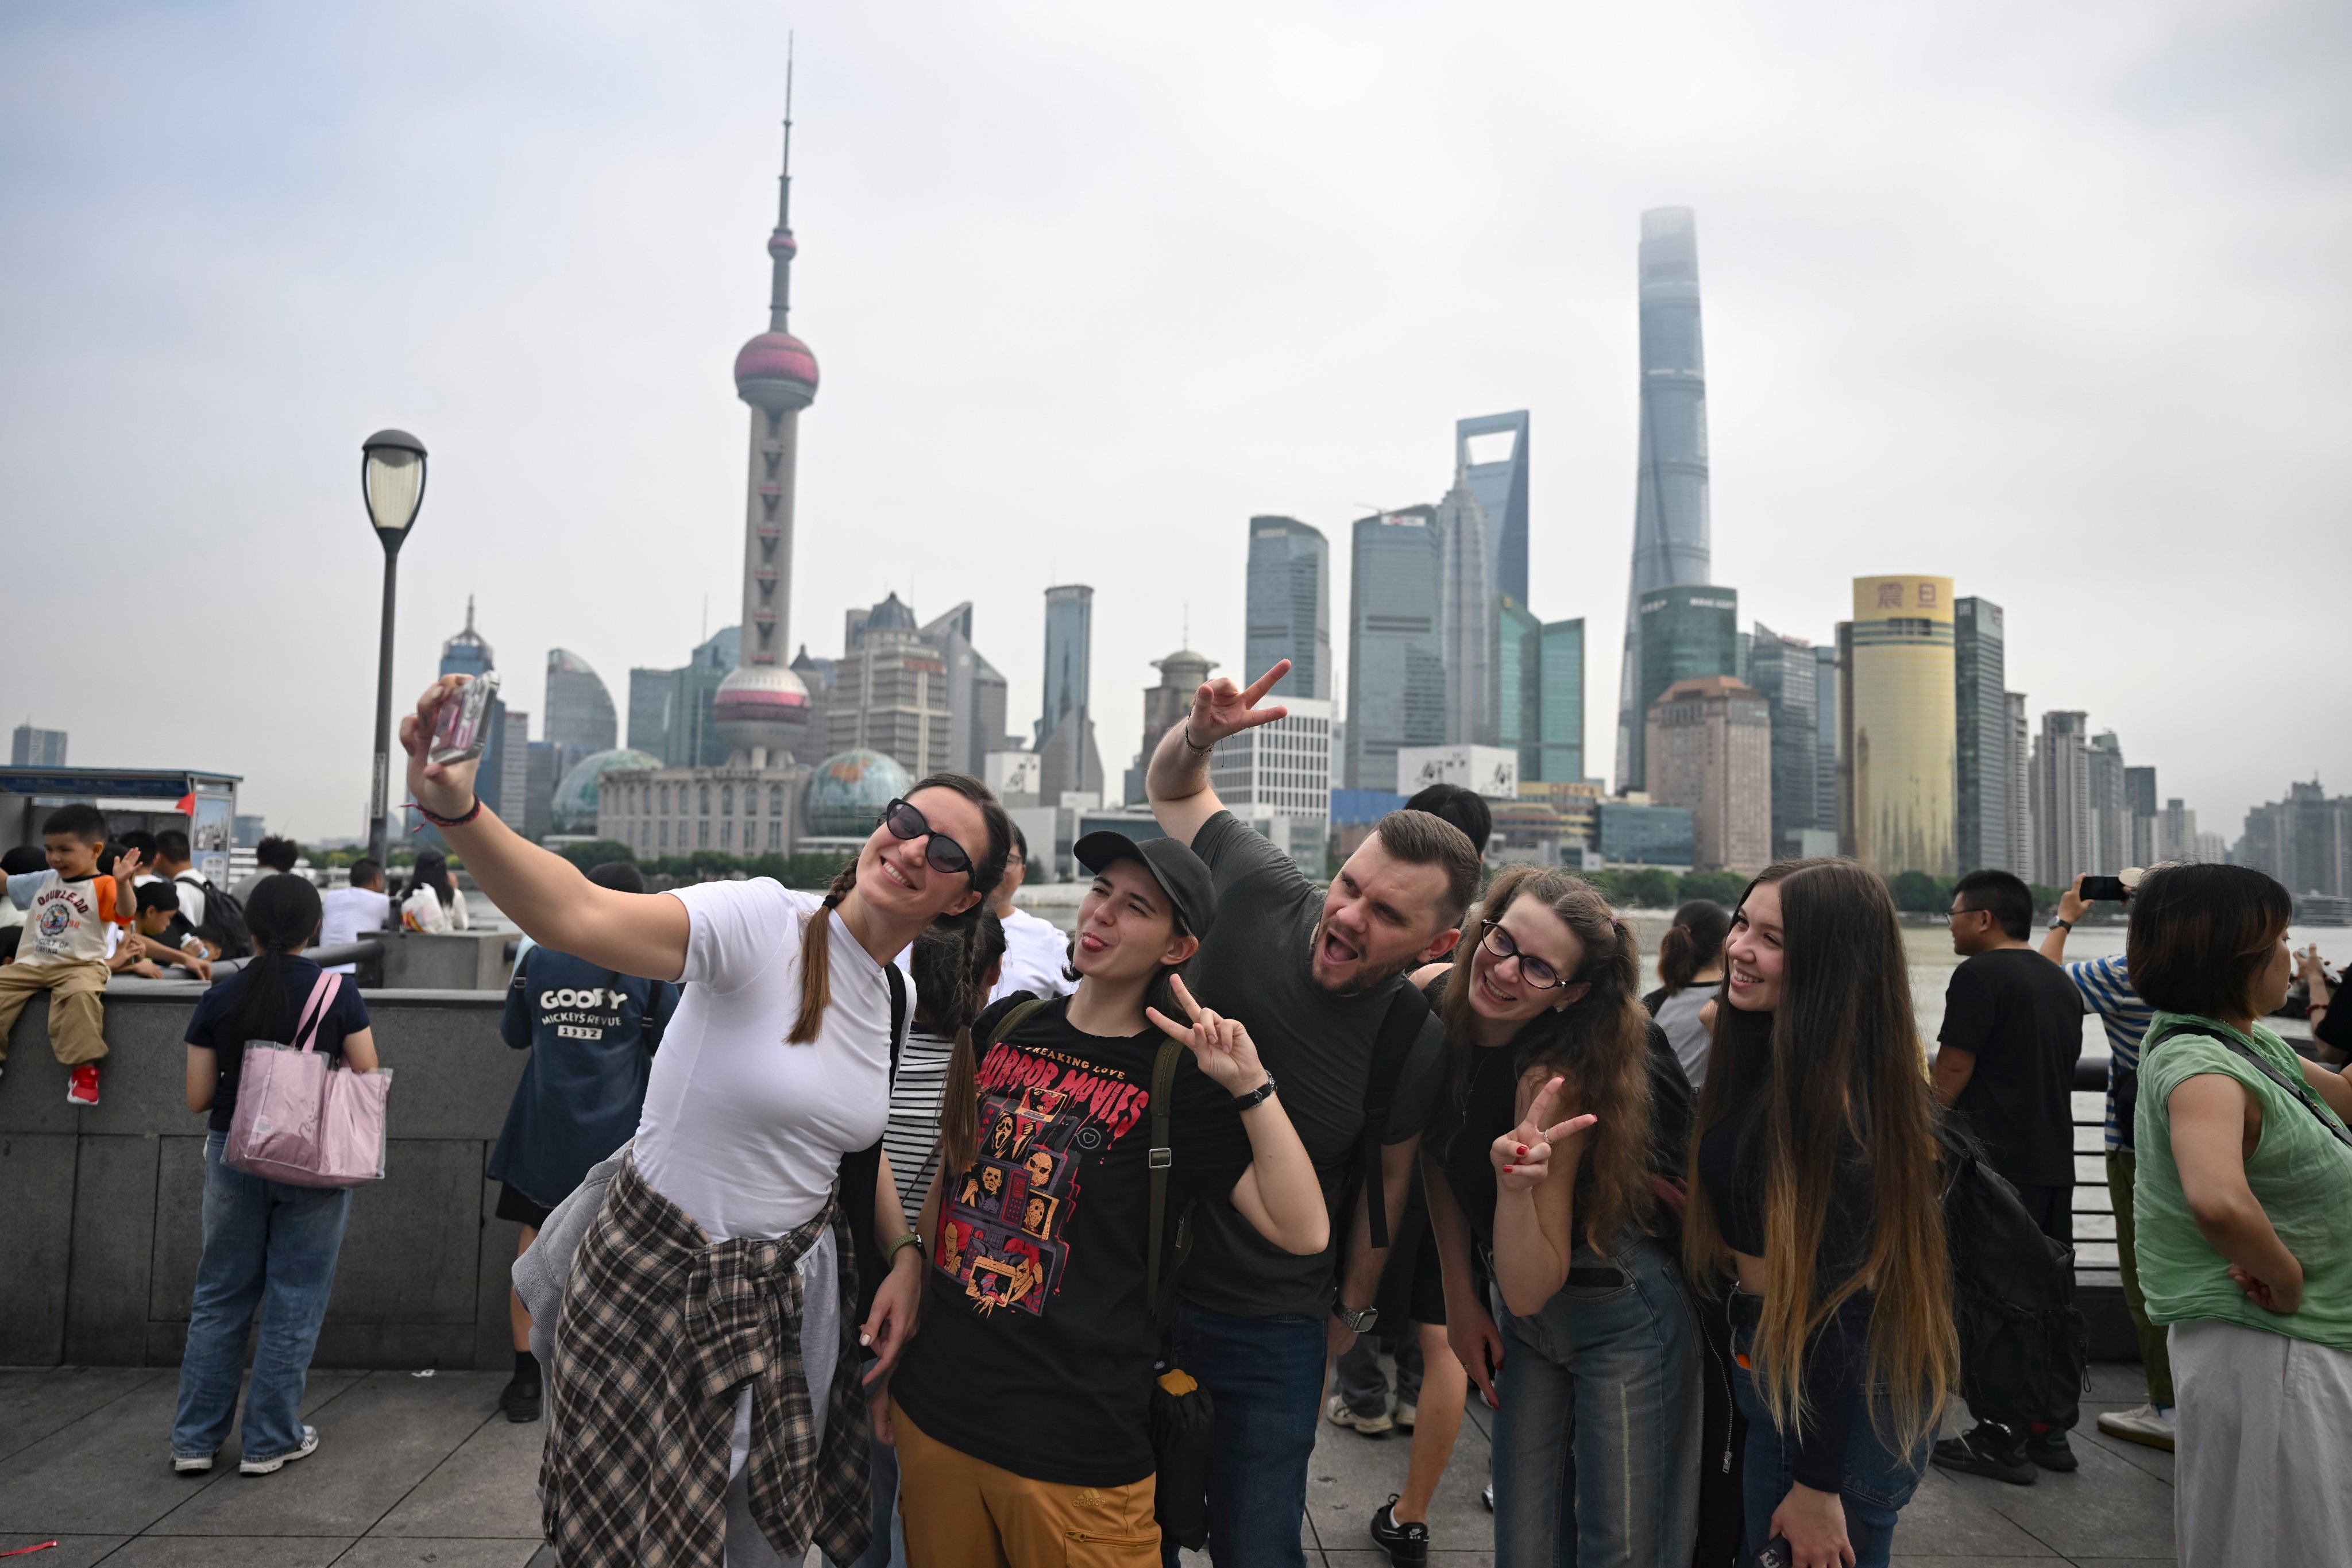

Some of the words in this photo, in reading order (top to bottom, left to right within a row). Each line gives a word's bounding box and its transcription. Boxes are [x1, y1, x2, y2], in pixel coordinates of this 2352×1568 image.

[1877, 581, 1938, 609] 震旦
[540, 988, 628, 1010] GOOFY
[542, 1011, 585, 1026] MICKEY'S
[587, 1014, 622, 1027] REVUE
[563, 1027, 598, 1038] 1932
[1093, 1065, 1125, 1080] LOVE
[1056, 1069, 1149, 1141] MOVIES
[1073, 1498, 1106, 1507] adidas
